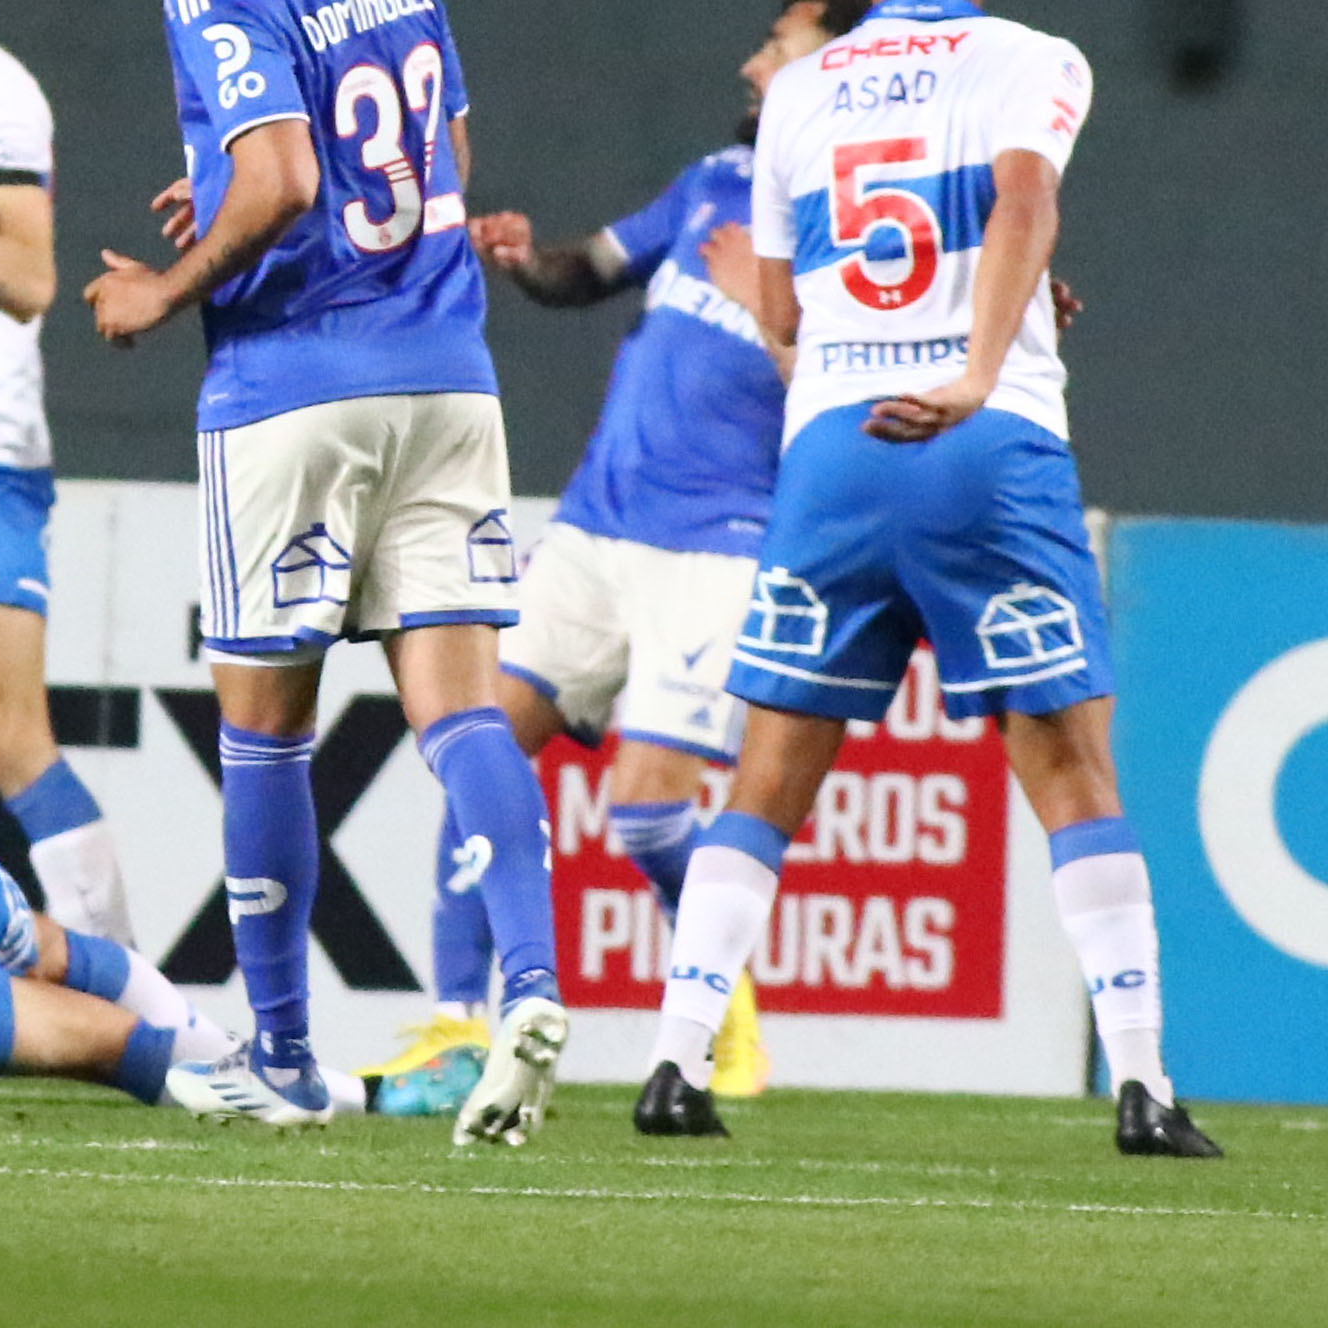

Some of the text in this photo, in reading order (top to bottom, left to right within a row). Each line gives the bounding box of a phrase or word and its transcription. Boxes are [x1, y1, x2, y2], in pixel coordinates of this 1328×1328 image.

[818, 31, 973, 72] CHERY
[831, 69, 938, 117] ASAD
[334, 39, 467, 253] 32
[828, 134, 943, 313] 5
